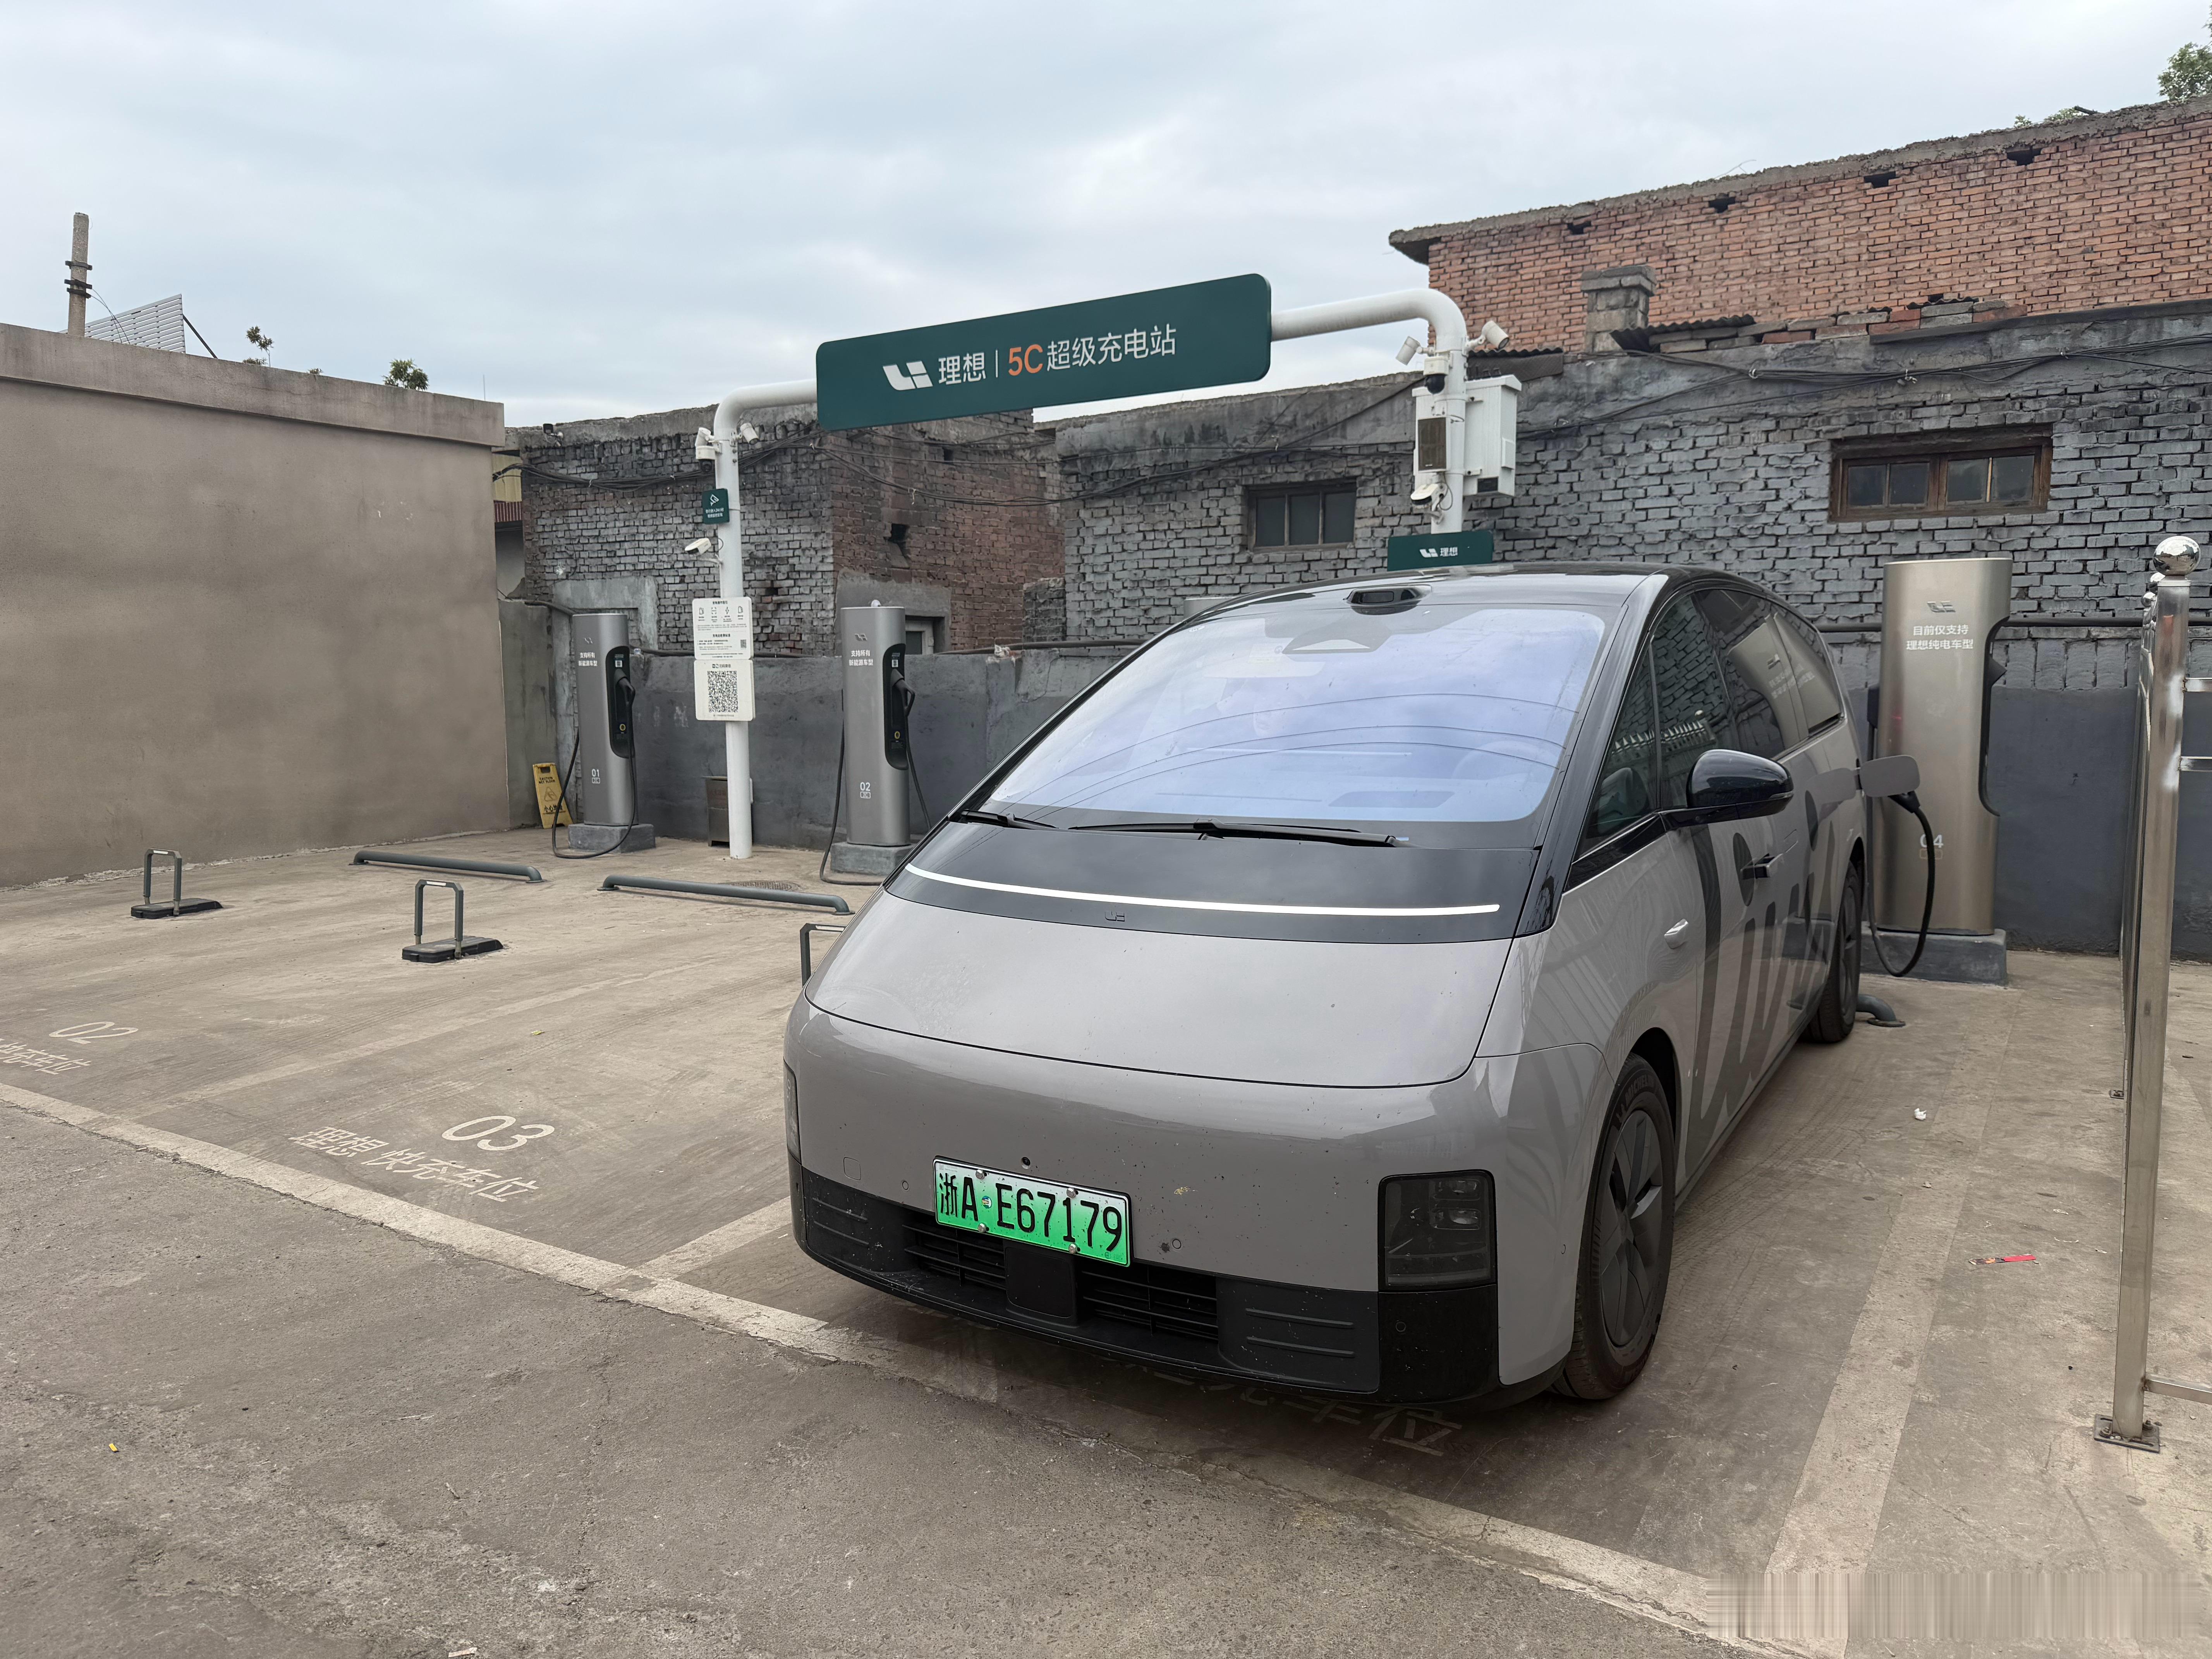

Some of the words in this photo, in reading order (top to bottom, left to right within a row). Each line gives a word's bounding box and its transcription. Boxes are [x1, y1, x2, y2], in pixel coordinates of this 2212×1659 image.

[938, 352, 987, 386] 理想
[1007, 323, 1177, 376] 5C超级充电站
[1440, 547, 1458, 557] 理想
[1913, 625, 1969, 636] 目前仅支持
[1906, 639, 1973, 651] 理想纯电车型
[592, 768, 599, 777] 01
[860, 782, 871, 791] 02
[49, 1021, 139, 1044] 02
[441, 1115, 555, 1151] 03
[288, 1126, 390, 1158] 理想
[361, 1148, 539, 1202] 快充车位
